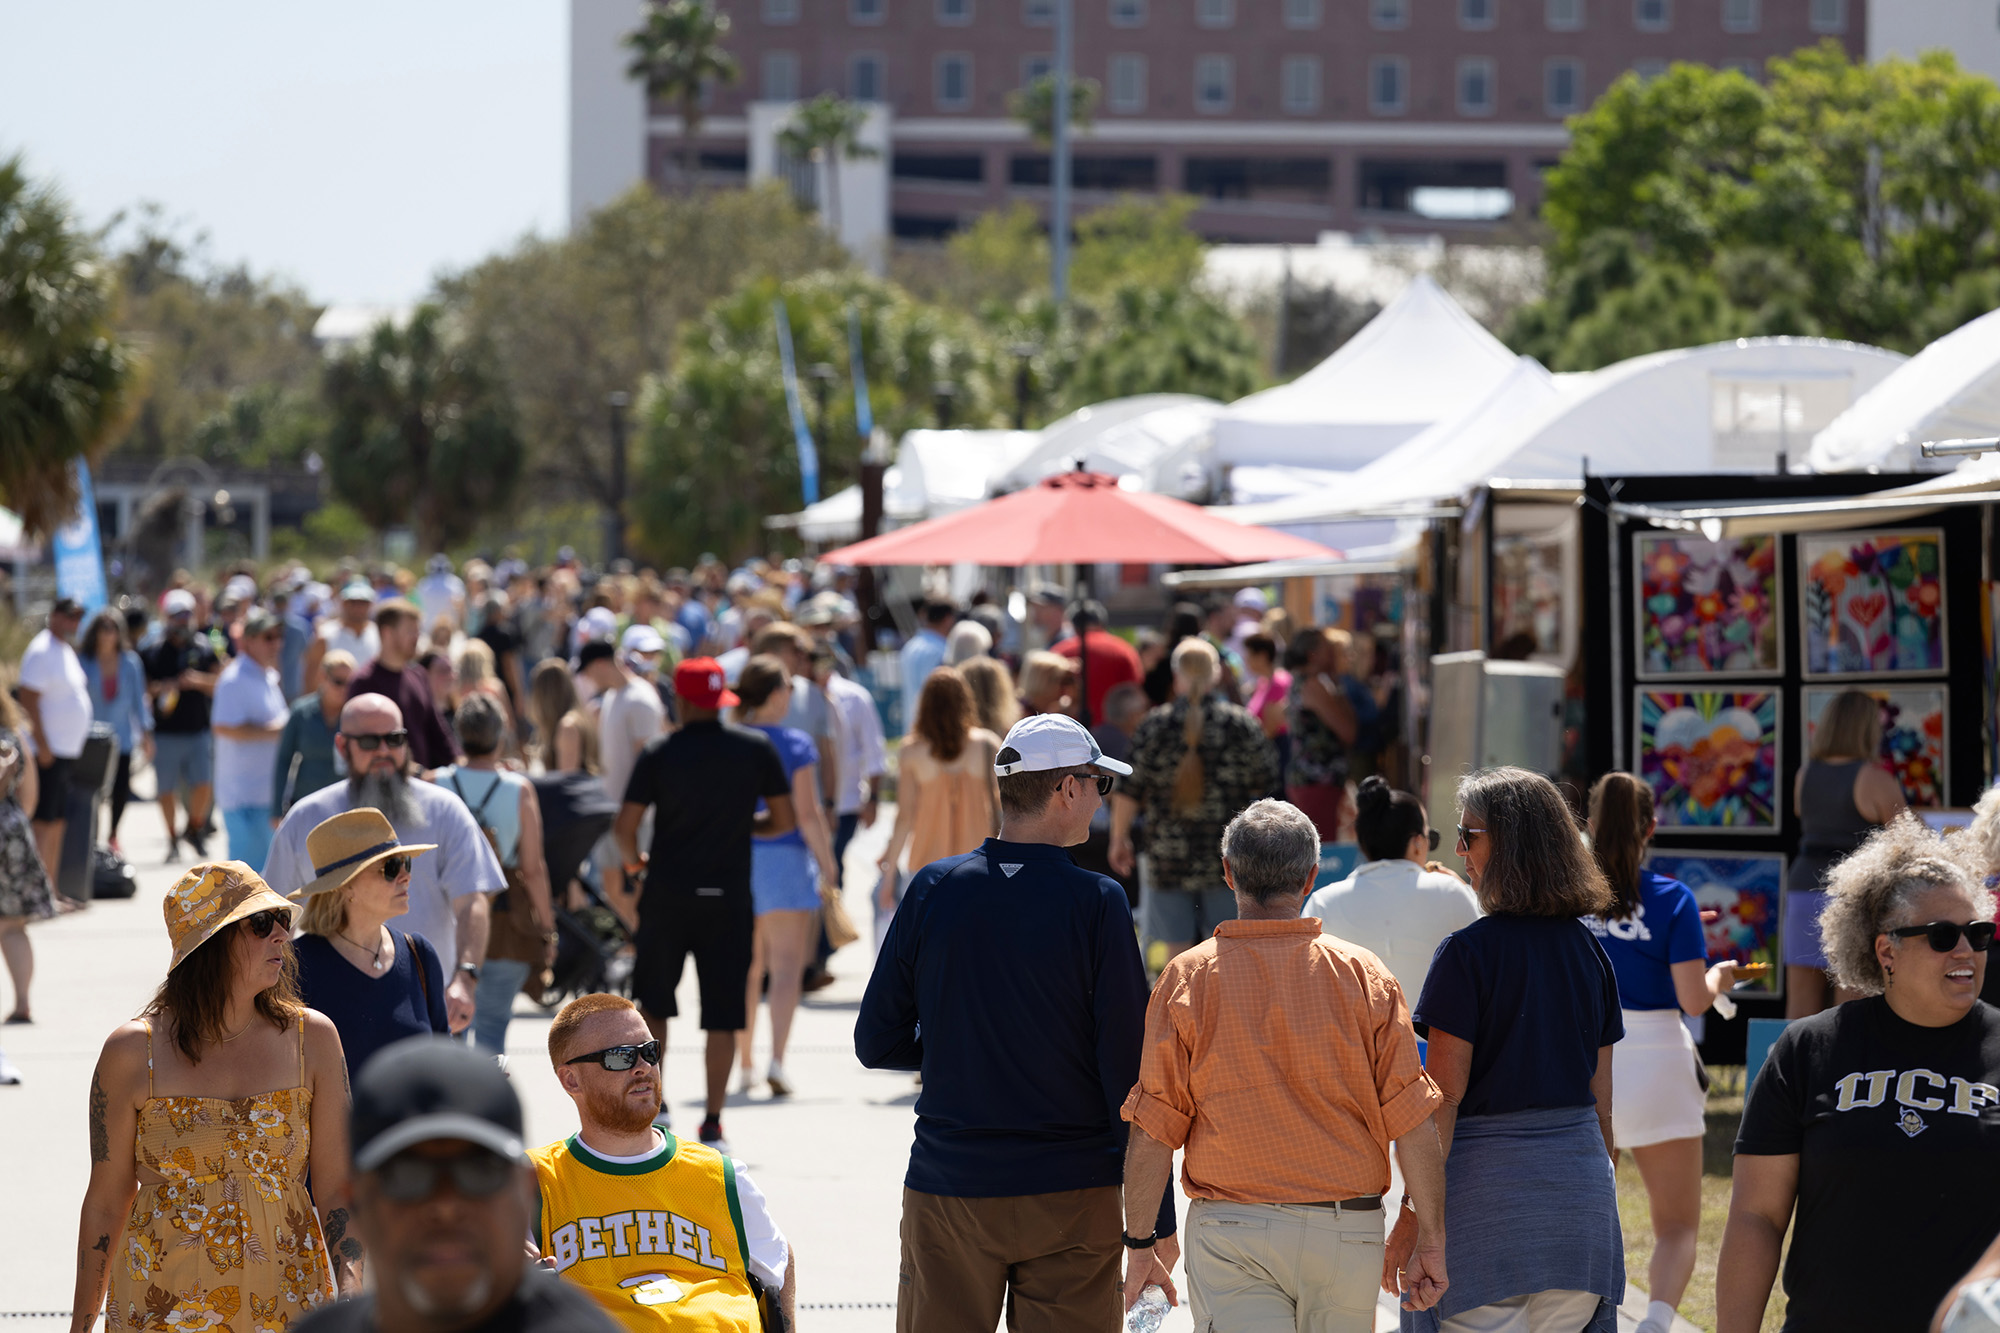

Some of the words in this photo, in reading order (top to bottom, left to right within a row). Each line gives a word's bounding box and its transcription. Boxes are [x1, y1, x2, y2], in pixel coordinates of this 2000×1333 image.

[1835, 1068, 2000, 1117] UCF
[551, 1210, 728, 1274] BETHEL
[96, 1259, 106, 1278] where
